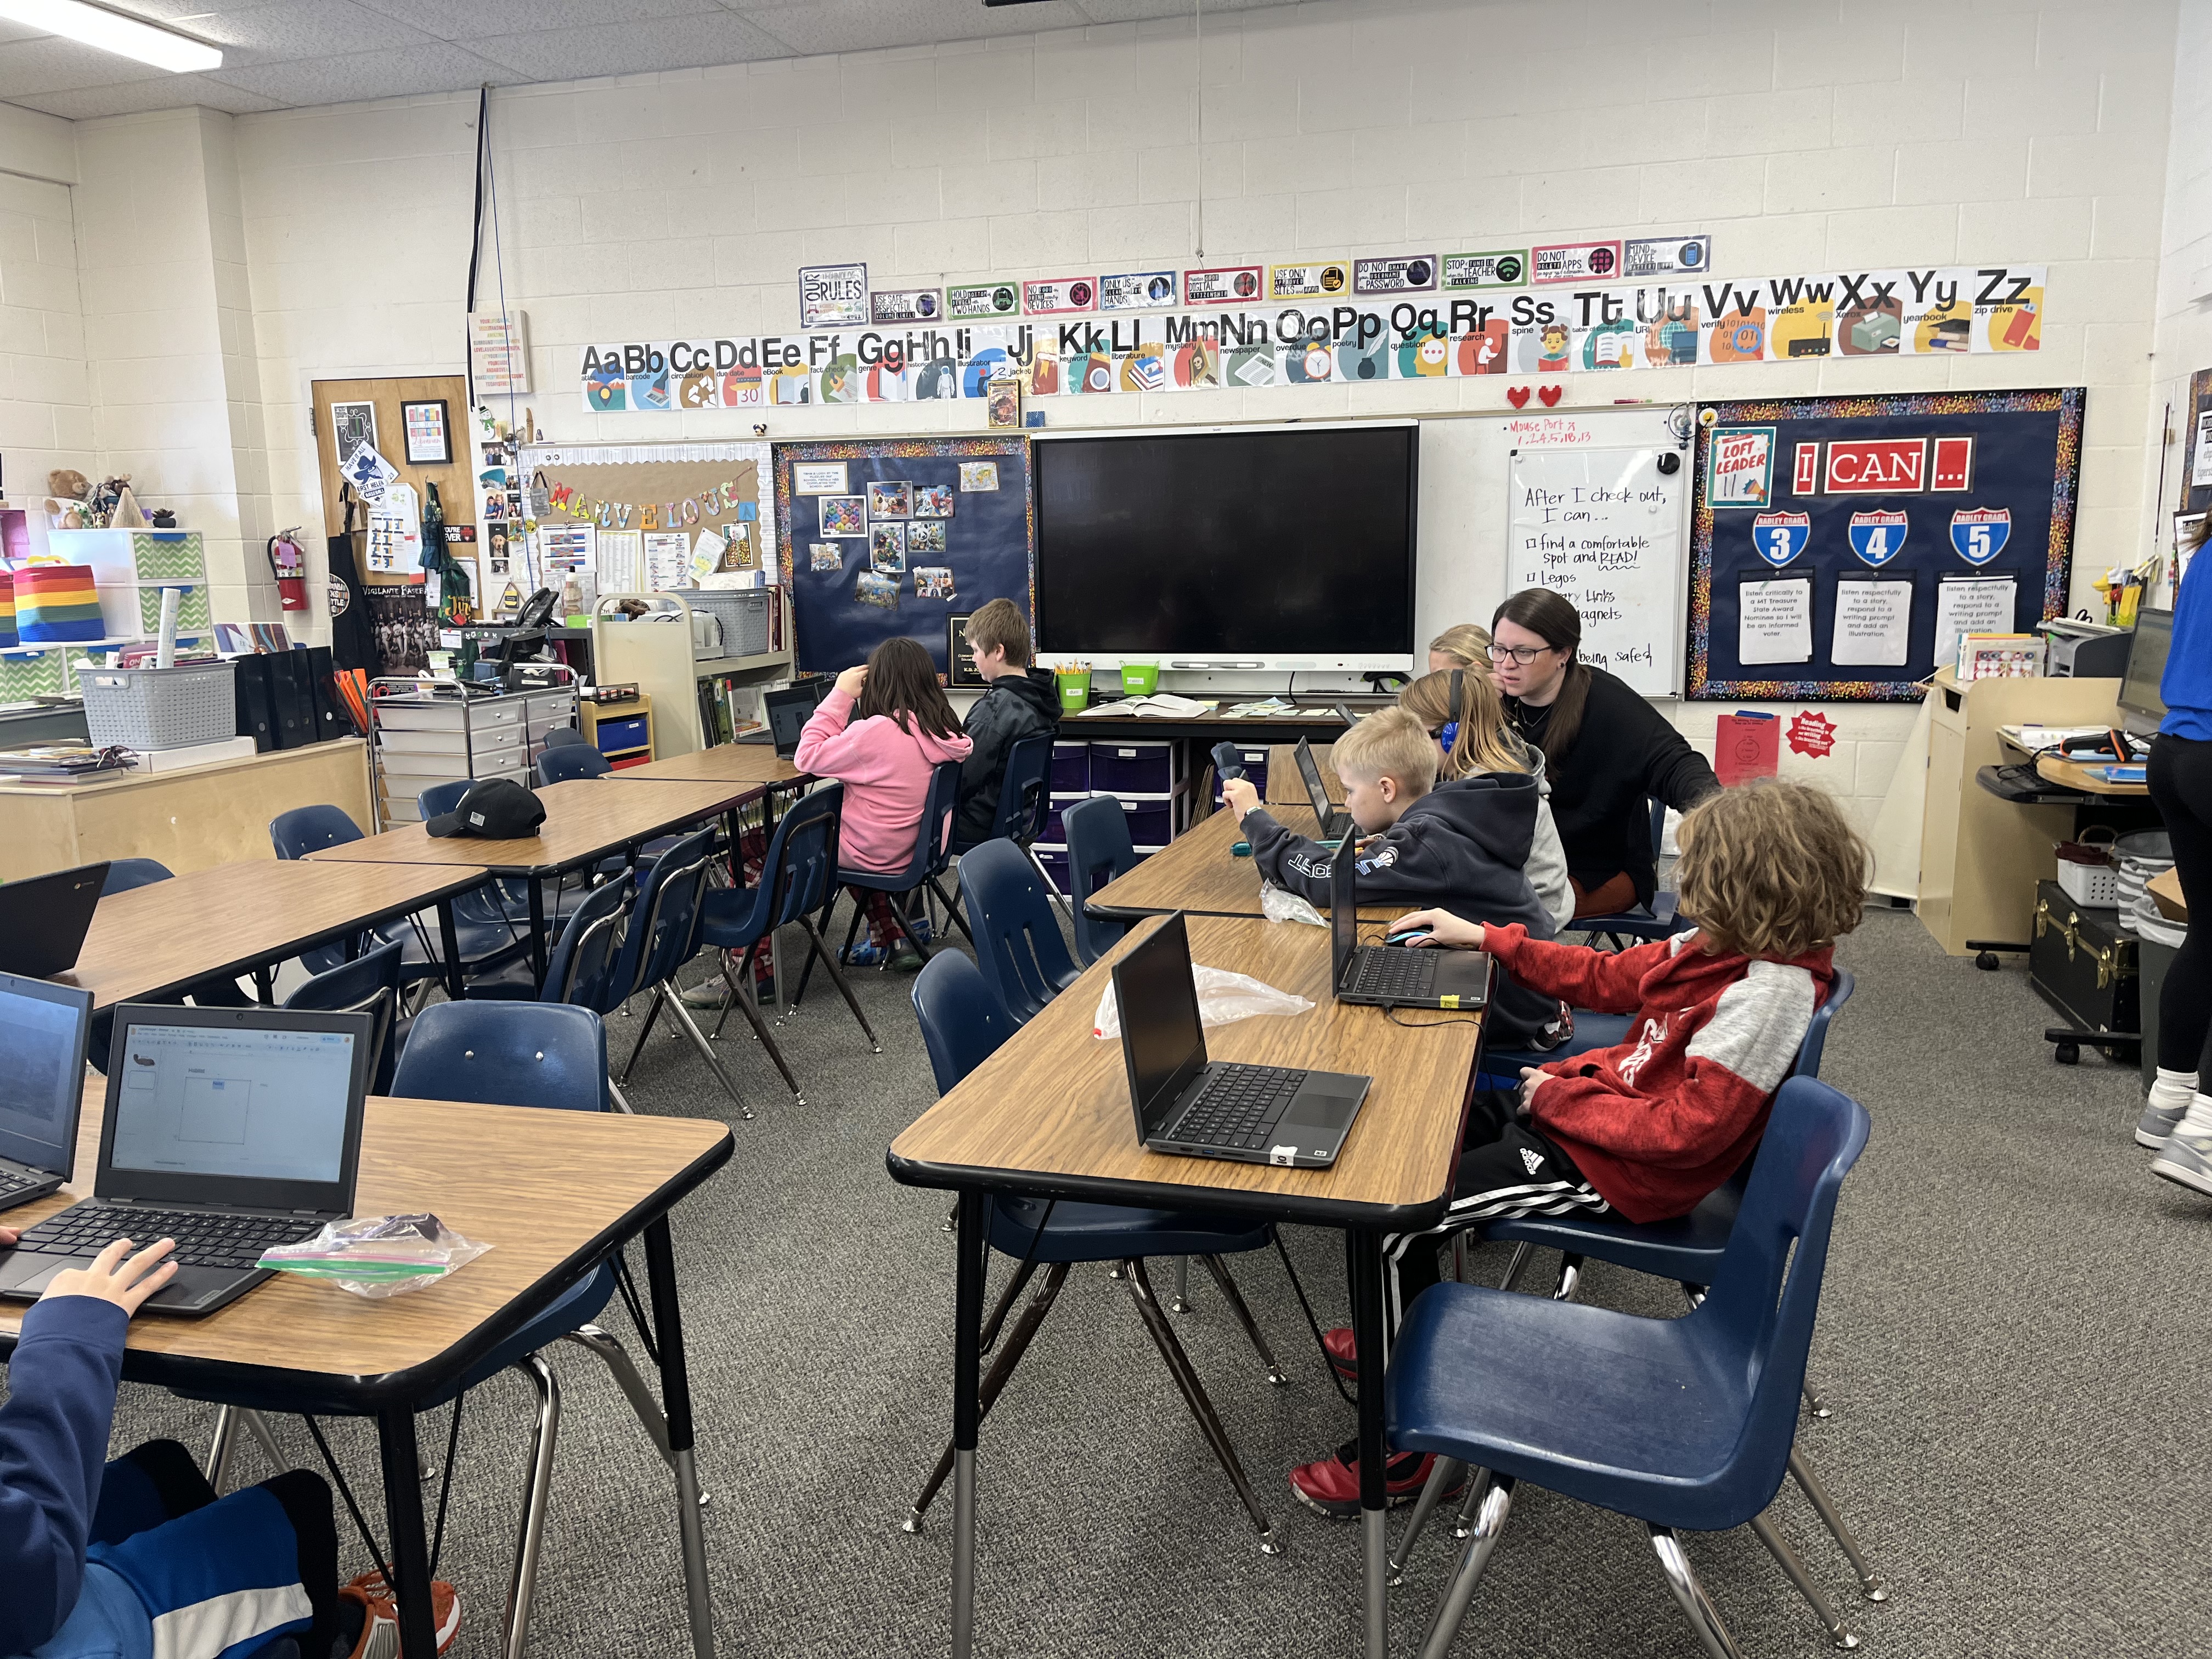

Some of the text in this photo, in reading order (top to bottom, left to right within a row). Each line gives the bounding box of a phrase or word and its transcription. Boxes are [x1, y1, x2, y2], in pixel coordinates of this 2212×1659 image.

[1537, 251, 1566, 262] DO NOT
[1629, 245, 1650, 255] MIND
[1629, 254, 1655, 264] DEVICE
[1274, 268, 1306, 279] USE ONLY
[1359, 263, 1369, 272] DO
[1372, 262, 1387, 272] NOT
[1447, 259, 1464, 270] STOP
[1463, 267, 1496, 278] TEACHER
[1537, 259, 1582, 270] DELETE APPS
[805, 274, 821, 302] OUR
[821, 280, 862, 301] RULES
[1028, 285, 1037, 294] NO
[1105, 279, 1121, 289] ONLY
[1189, 281, 1215, 291] DIGITAL
[1274, 286, 1295, 295] SITES
[1366, 279, 1404, 289] PASSWORD
[1769, 277, 1834, 306] Ww
[1836, 274, 1897, 311] Xx
[1908, 270, 1957, 312] Yy
[1975, 269, 2031, 305] Zz
[875, 295, 903, 304] USE SAFE
[951, 290, 967, 299] HOLD
[1105, 295, 1128, 305] HANDS
[1189, 290, 1228, 298] CITIZENSHIP
[1703, 283, 1759, 319] Vv
[875, 303, 912, 313] RESPECTFUL
[952, 304, 990, 315] TWO HANDS
[1028, 301, 1053, 310] DEVICES
[1511, 296, 1555, 326] Ss
[1573, 291, 1623, 326] Tt
[1637, 287, 1691, 324] Uu
[1768, 306, 1804, 315] wireless
[1836, 310, 1861, 318] Xerox
[1974, 305, 2013, 314] zip drive
[1391, 303, 1447, 340] Qq
[1450, 300, 1493, 333] Rr
[1701, 320, 1725, 329] verify
[1903, 313, 1947, 323] yearbook
[1166, 315, 1219, 343] Mm
[1221, 313, 1267, 346] Nn
[1276, 309, 1330, 343] Oo
[1333, 307, 1381, 349] Pp
[1059, 321, 1104, 354] Kk
[1111, 319, 1139, 352] Ll
[1333, 340, 1357, 349] poetry
[1449, 334, 1485, 342] research
[715, 338, 757, 370] Dd
[763, 338, 801, 368] Ee
[810, 335, 840, 366] Ff
[857, 332, 904, 373] Gg
[906, 330, 950, 362] Hh
[1007, 324, 1032, 366] Jj
[1165, 342, 1197, 351] mystery
[1220, 347, 1261, 355] newspaper
[1391, 341, 1425, 350] question
[581, 346, 620, 374] Aa
[624, 344, 663, 374] Bb
[670, 342, 710, 373] Cc
[1008, 368, 1031, 377] jacket
[741, 389, 758, 402] 30
[1510, 418, 1564, 432] Mouse Port
[345, 458, 357, 471] HAVE
[358, 446, 366, 455] ALL
[1723, 441, 1754, 459] LOFT
[1716, 453, 1765, 475] LEADER
[1799, 452, 1921, 483] I CAN
[357, 484, 369, 492] EAST
[1525, 486, 1666, 507] After I check out,
[549, 481, 738, 531] MARVELOUS
[1541, 507, 1558, 523] I
[1758, 516, 1806, 525] RADLEY GRADE
[1855, 515, 1904, 524] RADLEY GRADE
[1956, 514, 2008, 523] RADLEY GRADE
[1539, 533, 1564, 550] find
[1581, 535, 1650, 551] comfortable
[1769, 528, 1791, 560] 3
[1866, 527, 1887, 559] 4
[1968, 525, 1990, 558] 5
[1544, 550, 1638, 569] spot and READ!
[1542, 571, 1576, 589] Legos
[1579, 650, 1607, 672] being
[1519, 1148, 1536, 1175] adidas
